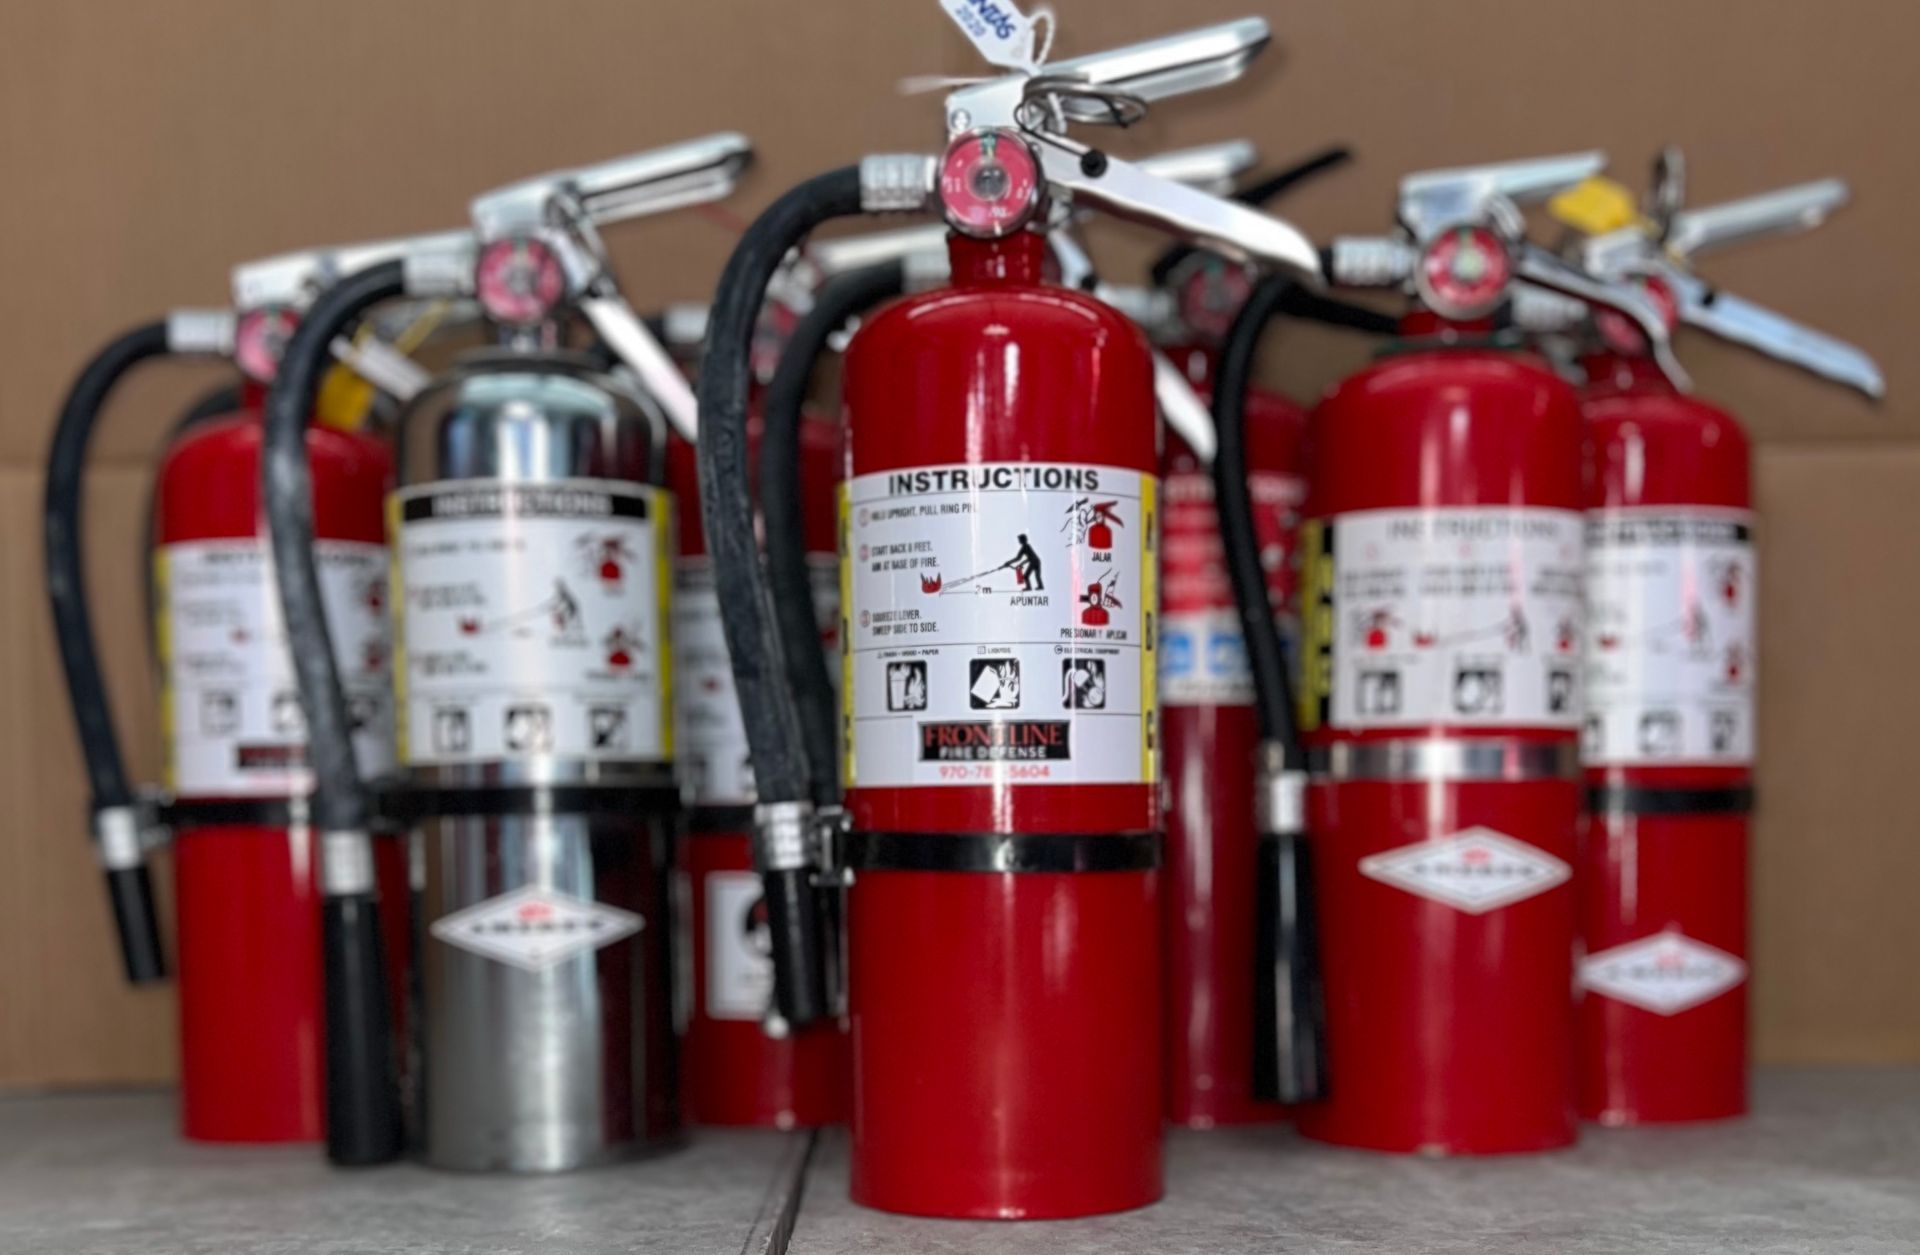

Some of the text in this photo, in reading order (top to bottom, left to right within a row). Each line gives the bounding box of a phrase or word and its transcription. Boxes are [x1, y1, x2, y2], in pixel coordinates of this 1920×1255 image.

[889, 467, 1099, 495] INSTRUCTIONS
[919, 504, 938, 516] PULL
[940, 503, 960, 514] RING
[890, 543, 906, 555] BACK
[1092, 552, 1112, 562] JALAR
[892, 559, 907, 570] BASE
[910, 558, 918, 568] OF
[921, 557, 940, 568] FIRE.
[1010, 596, 1049, 606] APUNTAR
[899, 609, 922, 621] LEVER.
[909, 623, 918, 633] TO
[920, 622, 940, 633] SIDE.
[1061, 627, 1096, 638] PRESIONAR
[925, 724, 1062, 747] FRONTLINE
[939, 746, 1046, 758] FIRE DEFENSE
